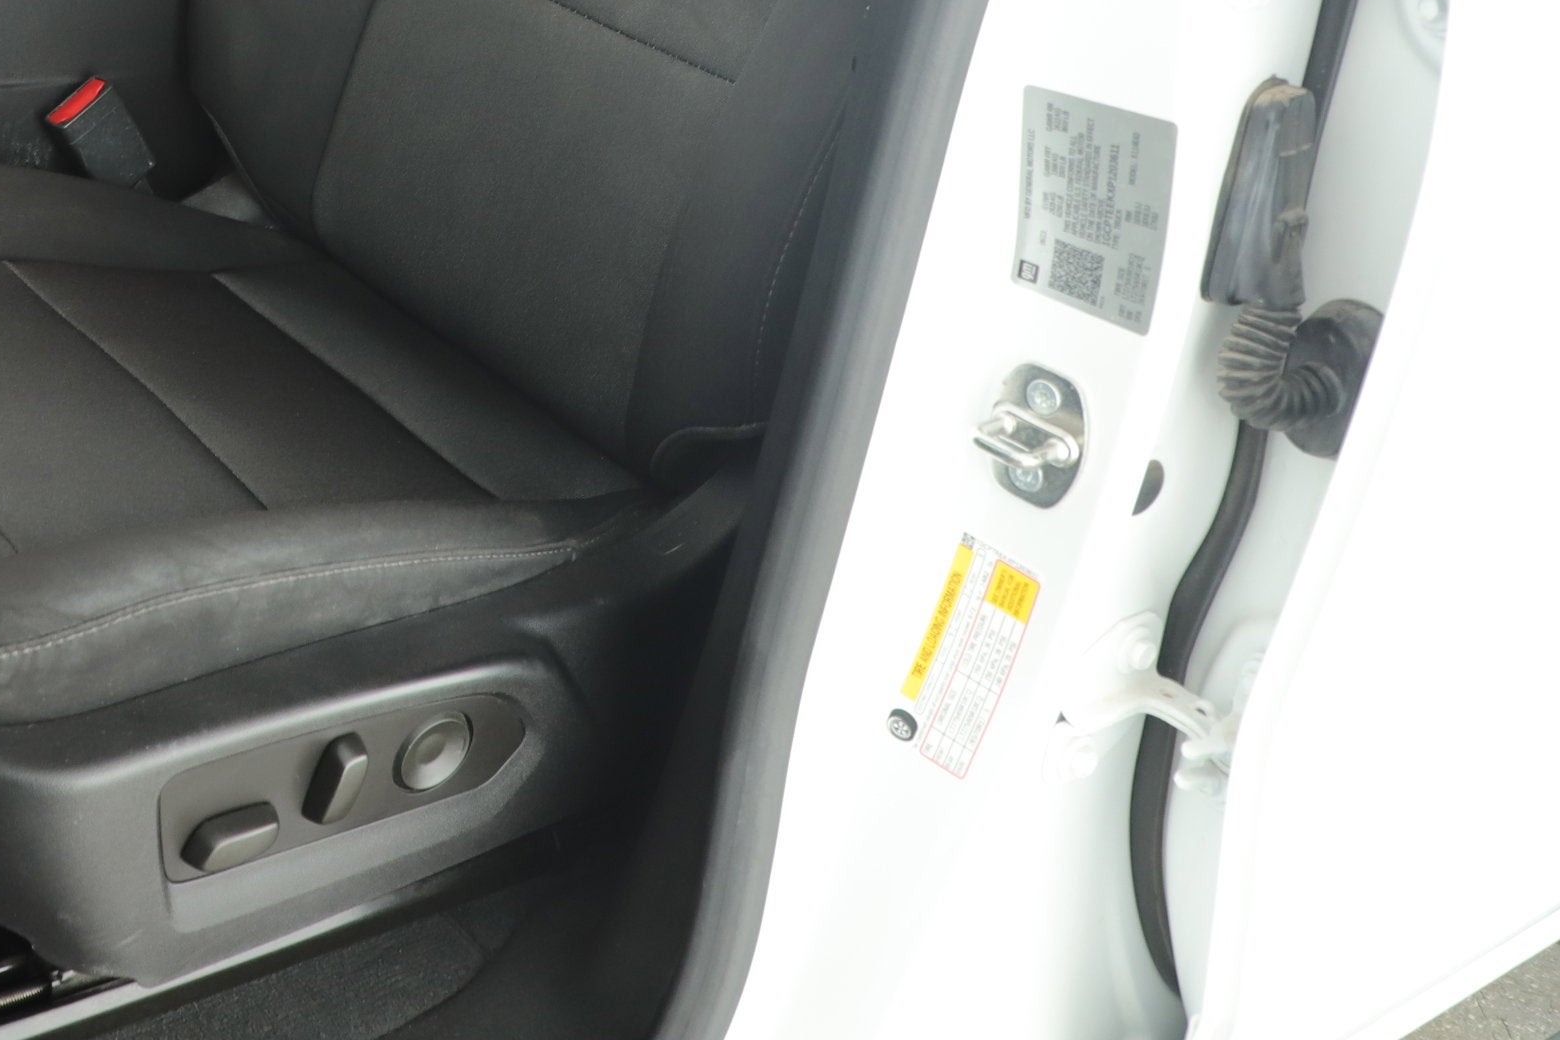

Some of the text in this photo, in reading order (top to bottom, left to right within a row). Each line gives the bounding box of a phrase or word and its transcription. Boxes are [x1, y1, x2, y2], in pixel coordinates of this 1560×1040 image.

[934, 566, 964, 619] INFORMATION
[922, 612, 946, 650] LOADING
[917, 642, 934, 664] AND
